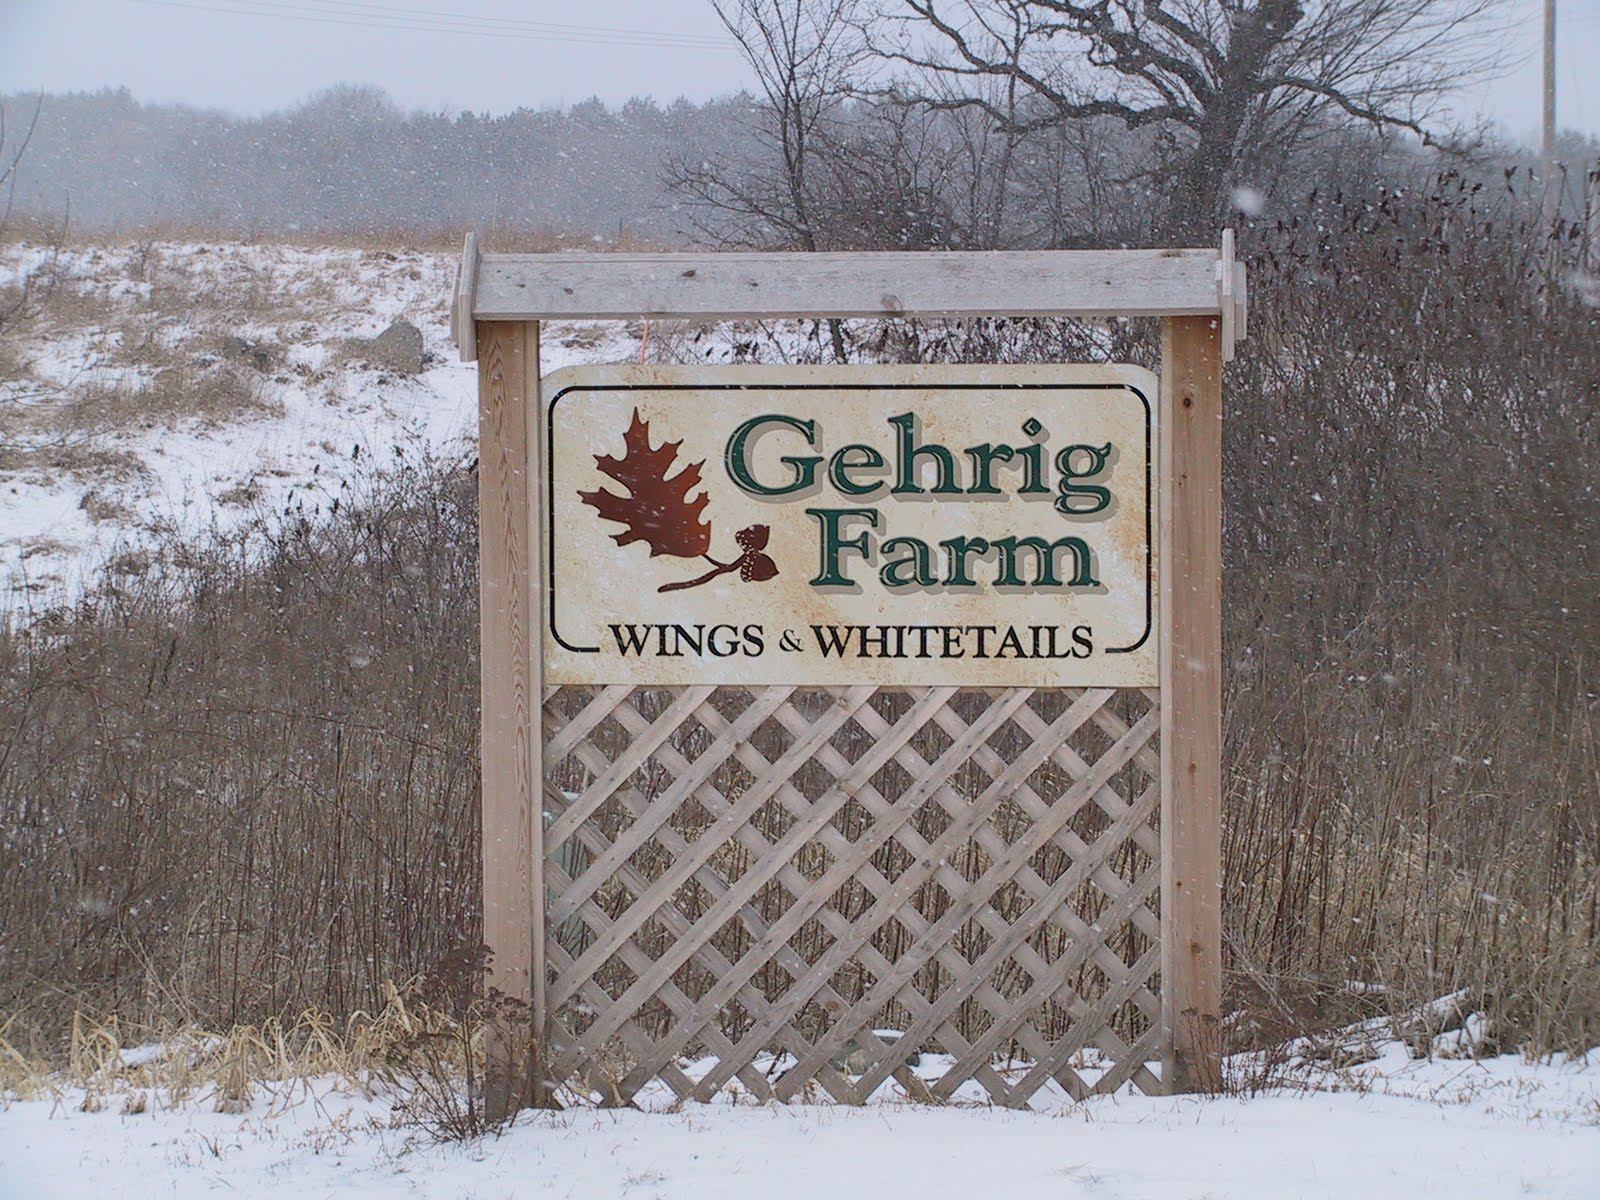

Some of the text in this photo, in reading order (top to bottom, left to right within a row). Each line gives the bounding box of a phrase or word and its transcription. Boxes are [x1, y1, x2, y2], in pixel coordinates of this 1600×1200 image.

[724, 411, 1113, 515] Gehrig
[806, 507, 1101, 588] Farm
[607, 623, 1094, 659] WINGS & WHITETAILS
